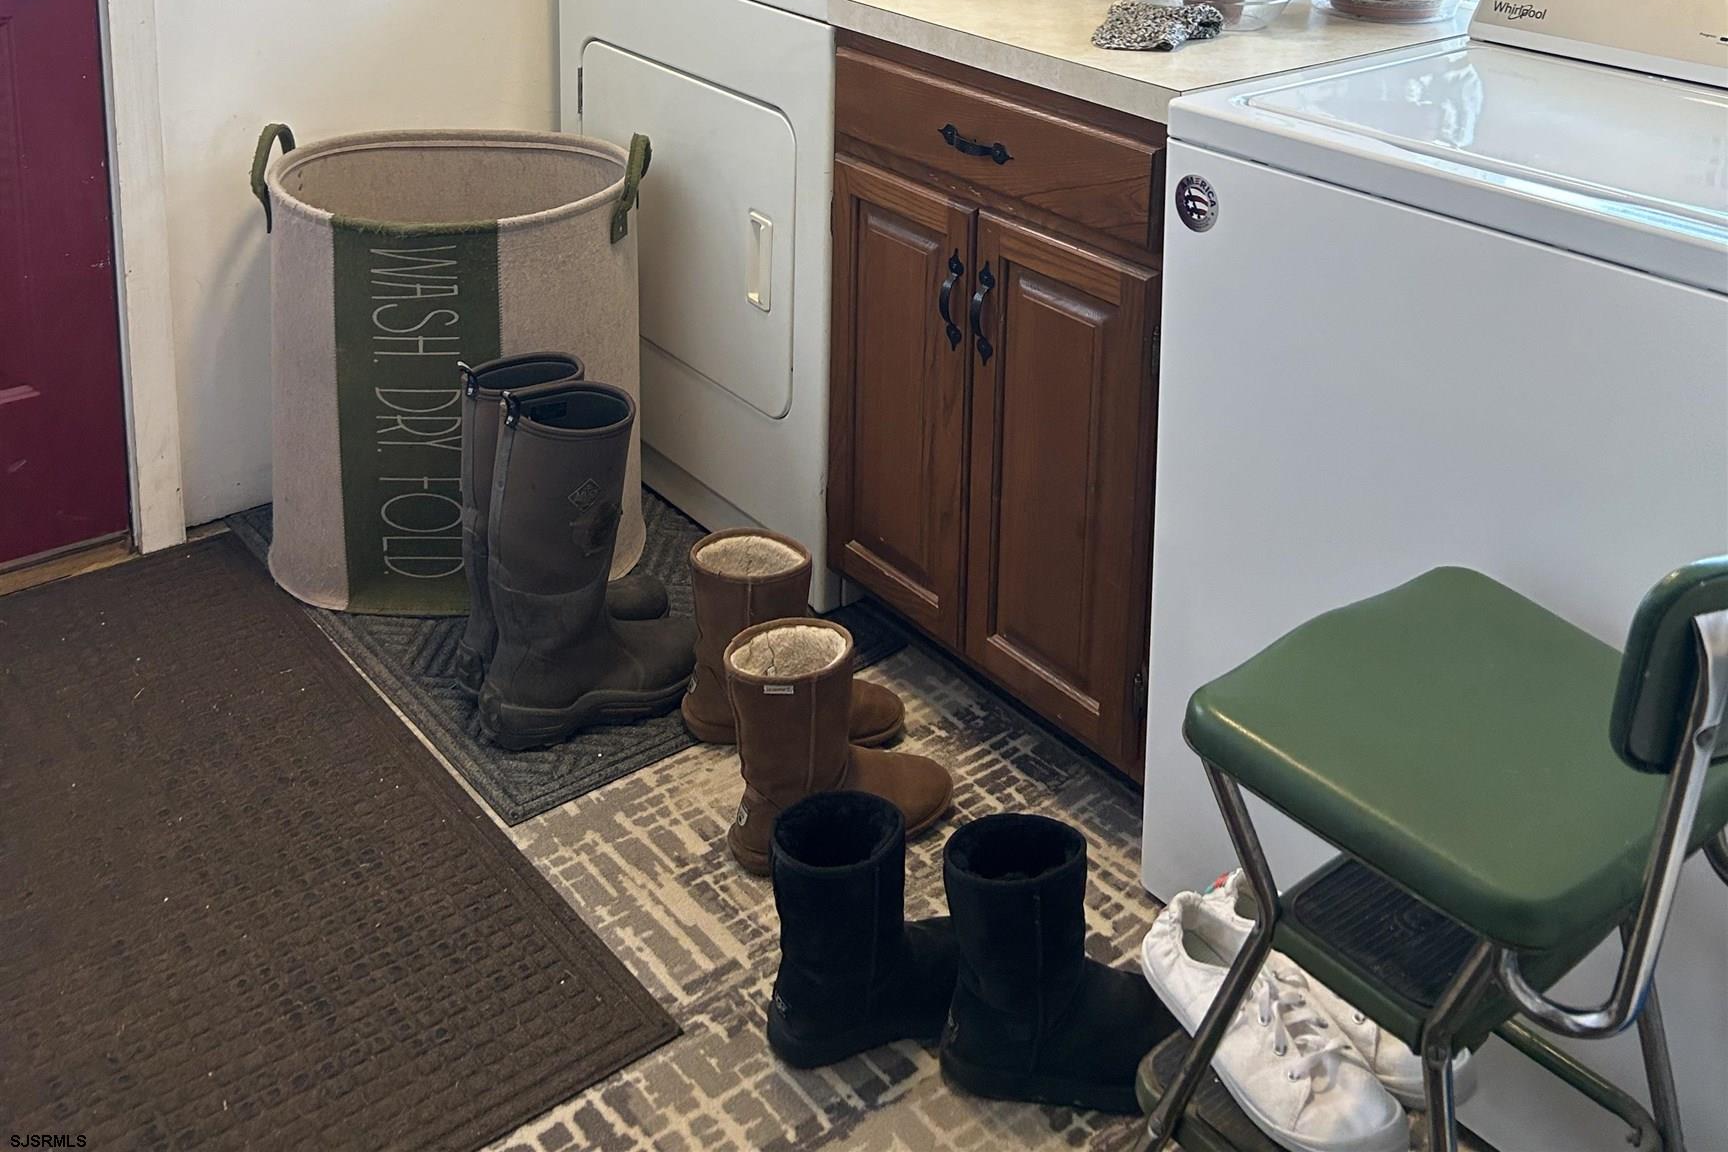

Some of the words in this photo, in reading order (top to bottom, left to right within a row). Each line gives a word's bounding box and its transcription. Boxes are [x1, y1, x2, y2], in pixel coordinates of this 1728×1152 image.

[1493, 0, 1547, 20] Whirlpool
[1181, 176, 1217, 208] AMERICA
[369, 245, 461, 363] WASH.
[375, 386, 462, 453] DRY.
